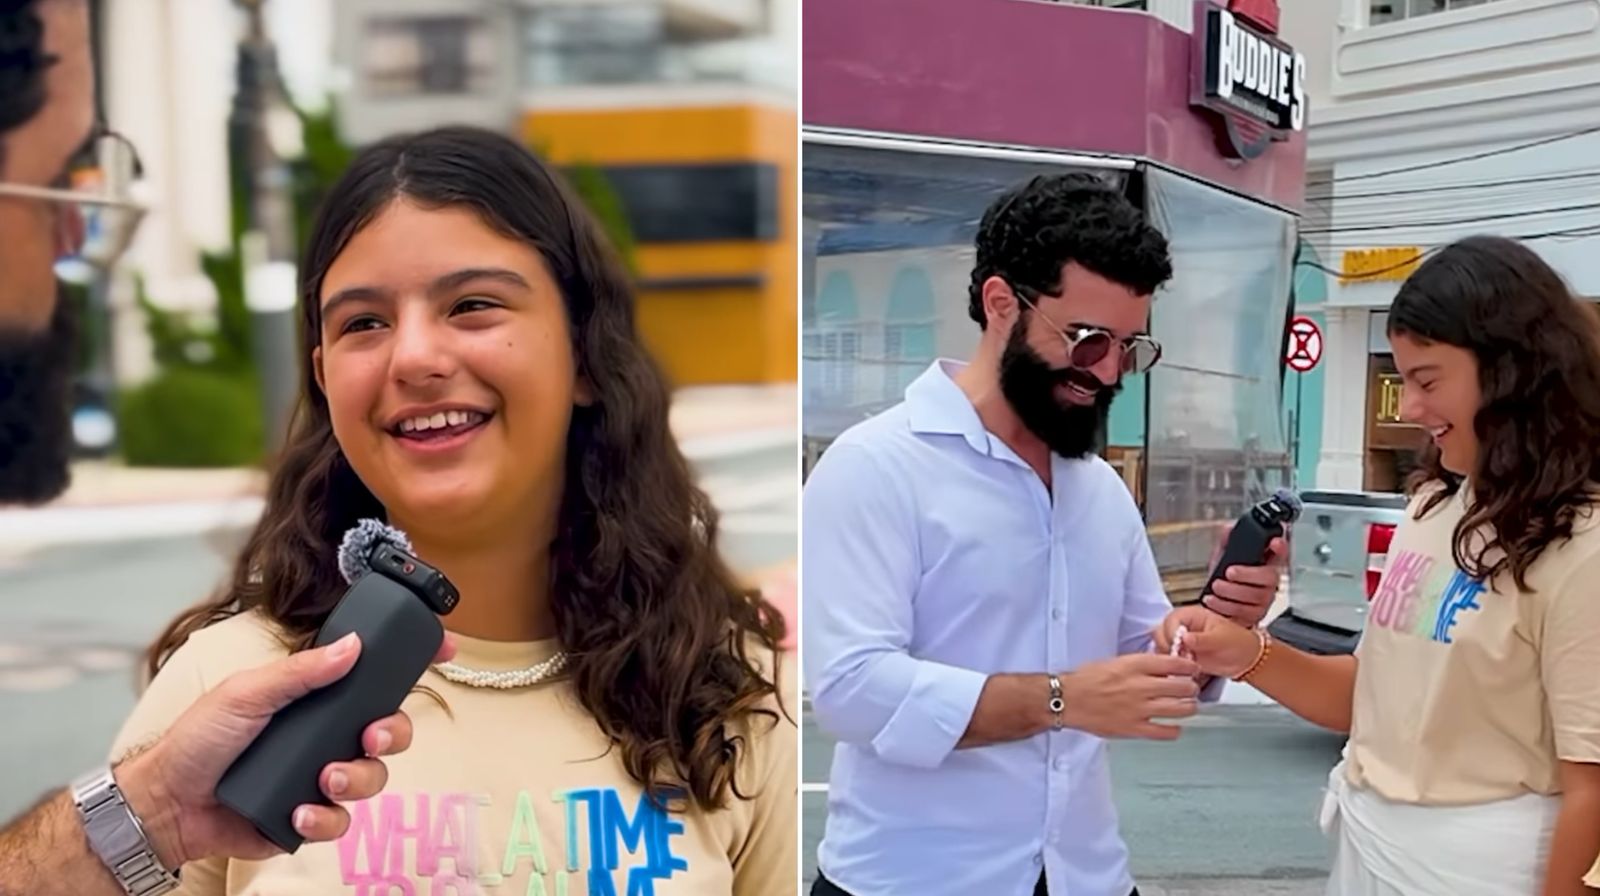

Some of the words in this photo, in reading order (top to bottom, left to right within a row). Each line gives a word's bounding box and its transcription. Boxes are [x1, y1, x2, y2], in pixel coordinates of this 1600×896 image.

[336, 793, 491, 884] WHAT
[502, 789, 547, 877] A
[552, 787, 688, 877] TIME
